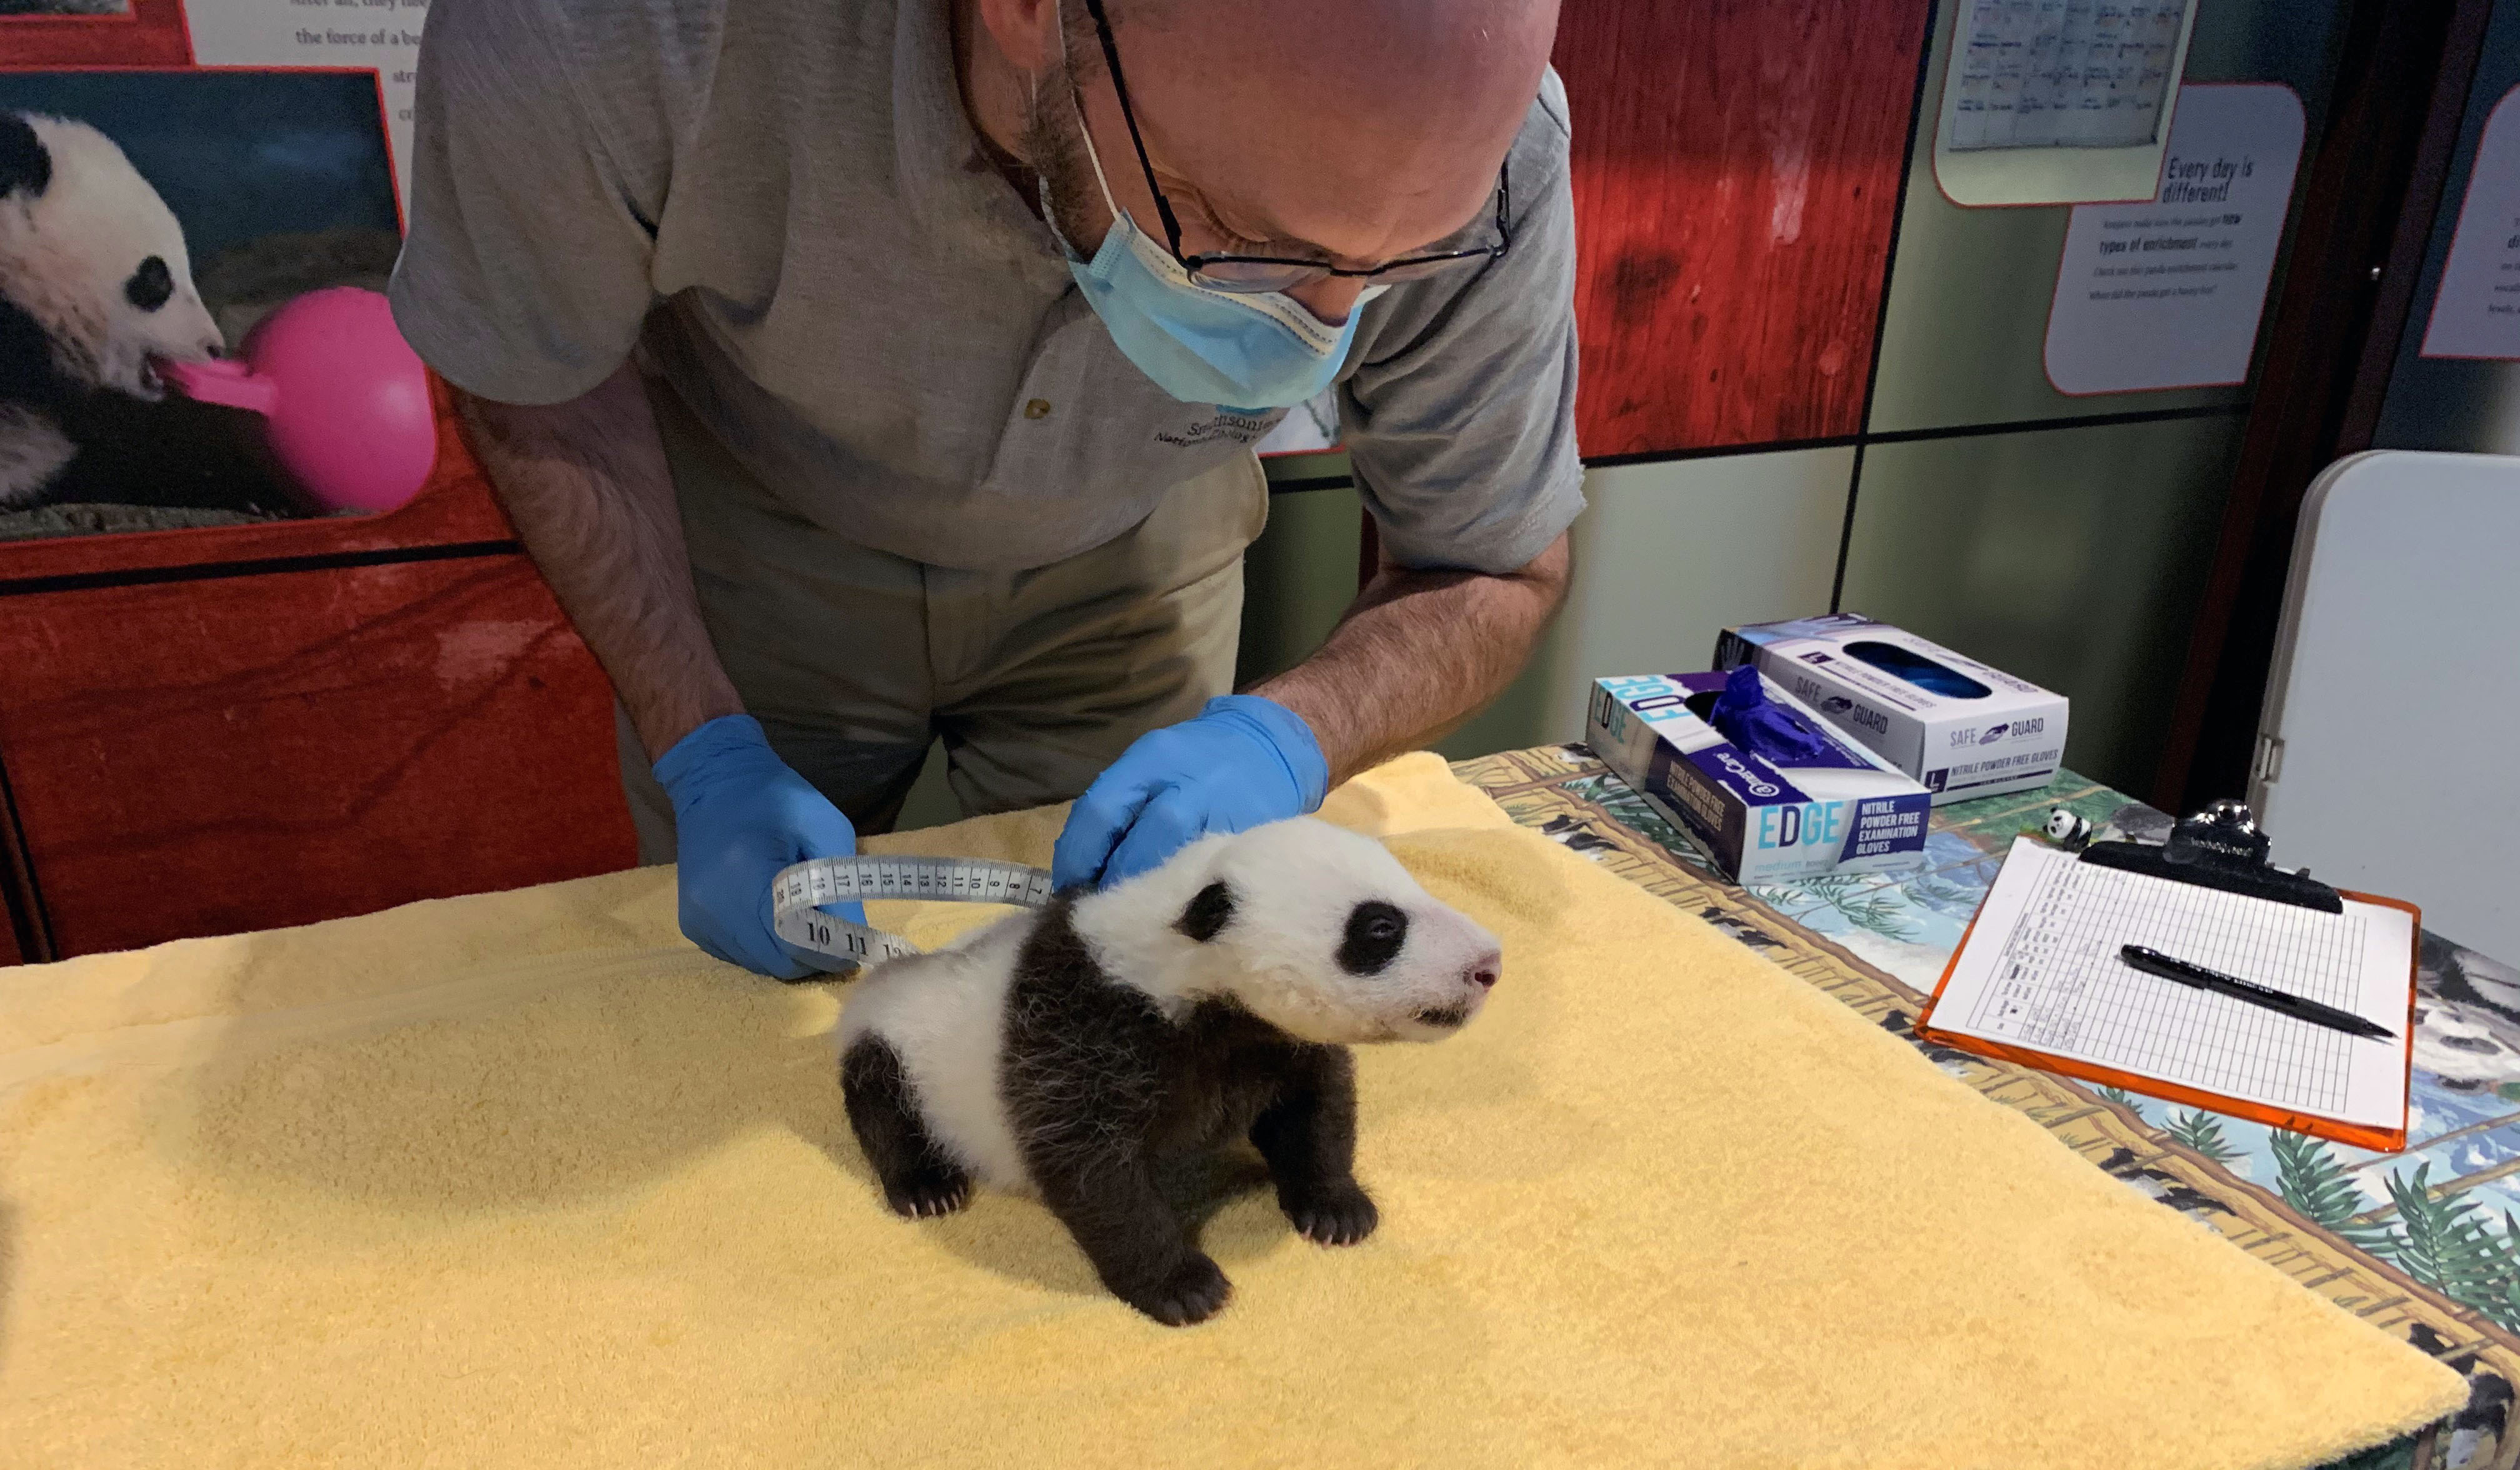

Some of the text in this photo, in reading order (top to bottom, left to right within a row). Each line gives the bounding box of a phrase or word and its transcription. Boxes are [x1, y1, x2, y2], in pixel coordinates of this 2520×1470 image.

[296, 28, 420, 46] the force of a be
[392, 70, 416, 83] str
[2168, 156, 2252, 183] Every day is
[1794, 676, 1889, 735] SAFE GUARD
[1950, 717, 2044, 748] SAFE GUARD
[1950, 748, 2059, 777] NITRILE POWDER FREE GLOVES
[1861, 800, 1895, 816] NITRILE
[1758, 801, 1844, 850] EDGE
[1860, 811, 1921, 829] POWDER FREE
[1858, 825, 1919, 842] EXAMINATION
[1856, 841, 1891, 855] GLOVES
[1754, 859, 1802, 872] medium
[835, 874, 851, 888] 17
[860, 874, 874, 887] 16
[882, 873, 894, 886] 15
[902, 874, 912, 886] 14
[919, 874, 930, 887] 13
[937, 875, 948, 888] 12
[954, 876, 964, 888] 11
[971, 877, 982, 889] 10
[1029, 888, 1042, 896] 7
[806, 920, 831, 946] 10
[846, 932, 869, 957] 11
